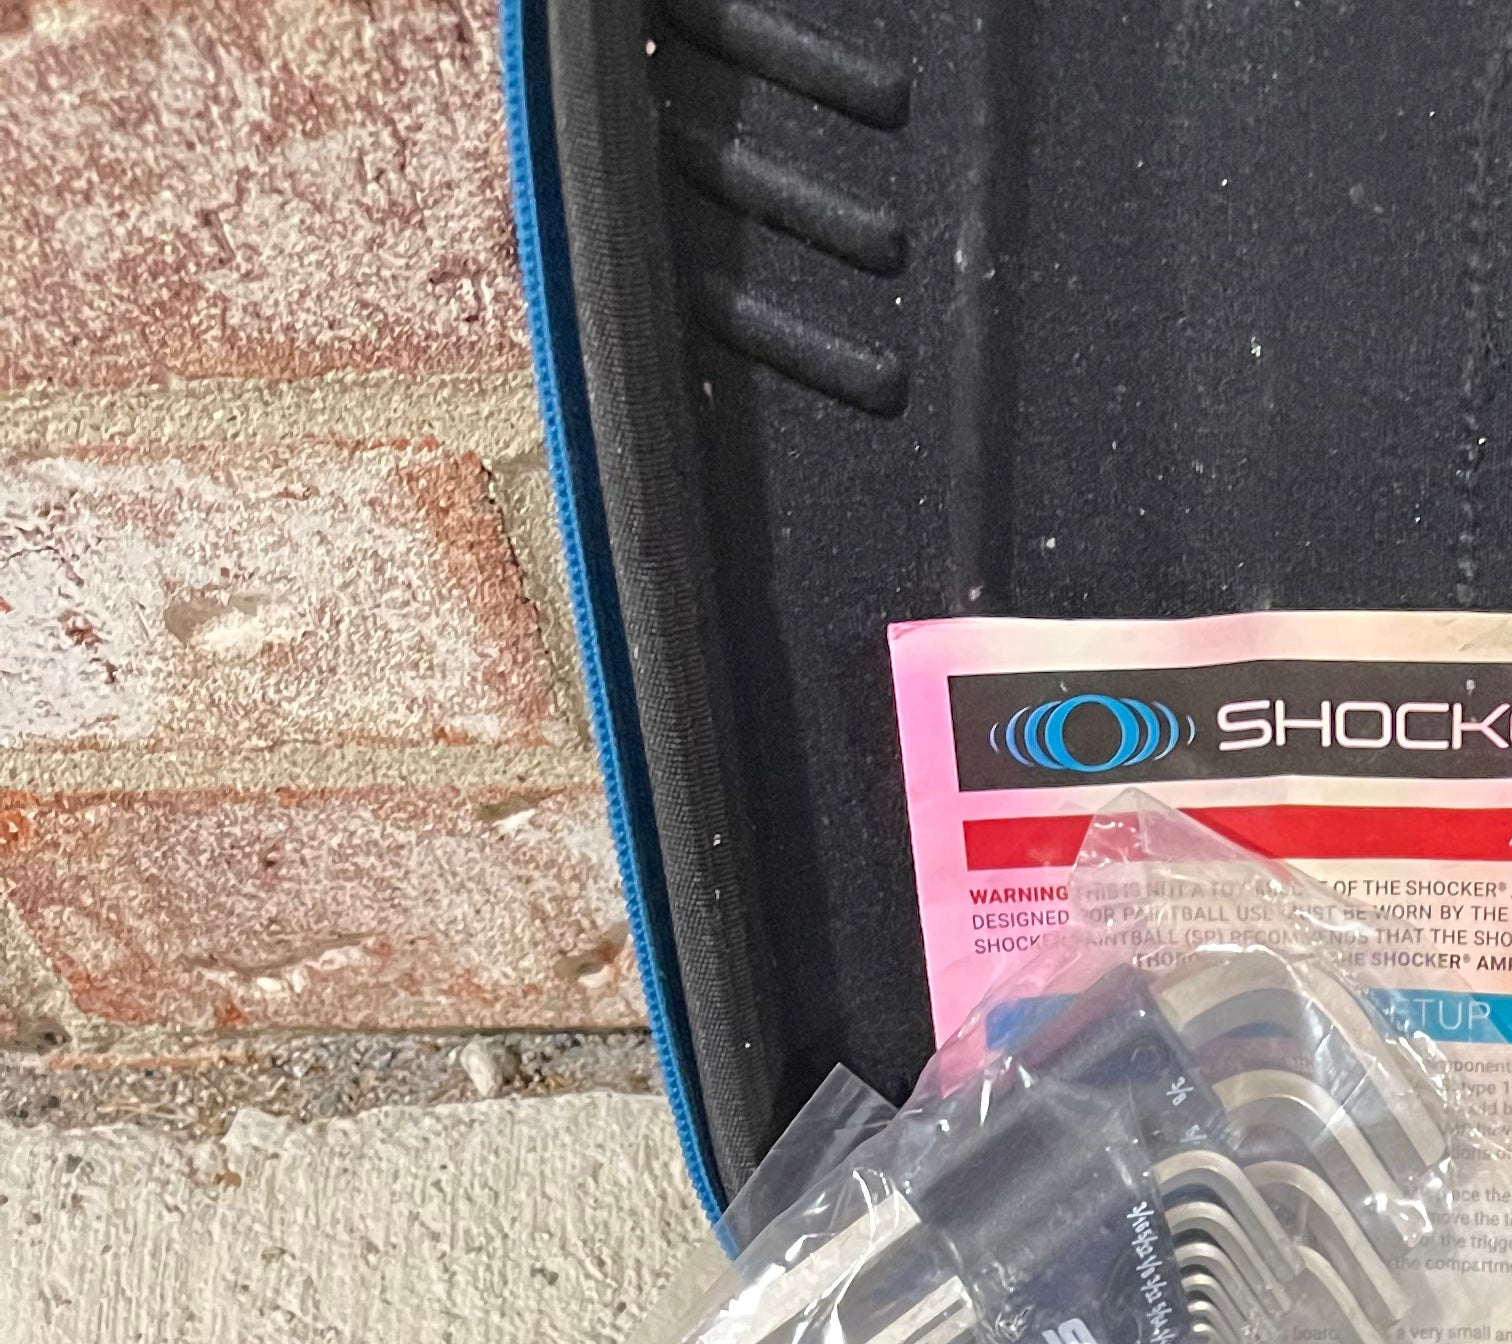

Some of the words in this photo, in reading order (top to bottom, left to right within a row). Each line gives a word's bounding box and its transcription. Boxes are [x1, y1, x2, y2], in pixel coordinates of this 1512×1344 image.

[968, 885, 1069, 905] WARNING
[1076, 881, 1119, 901] HIS
[1332, 879, 1358, 897] OF
[1363, 879, 1401, 896] THE
[971, 909, 1070, 931] DESIGNED
[1372, 904, 1432, 921] WORN
[1439, 904, 1464, 921] BY
[1470, 905, 1508, 922] THE
[973, 933, 1042, 955] SHOCK
[1086, 930, 1178, 948] AINTBALL
[1375, 926, 1424, 945] THAT
[1429, 928, 1468, 946] THE
[1180, 1124, 1208, 1145] 5/
[1485, 1186, 1511, 1204] the
[1474, 1210, 1500, 1226] the
[1410, 1327, 1444, 1344] very
[1447, 1323, 1491, 1341] small
